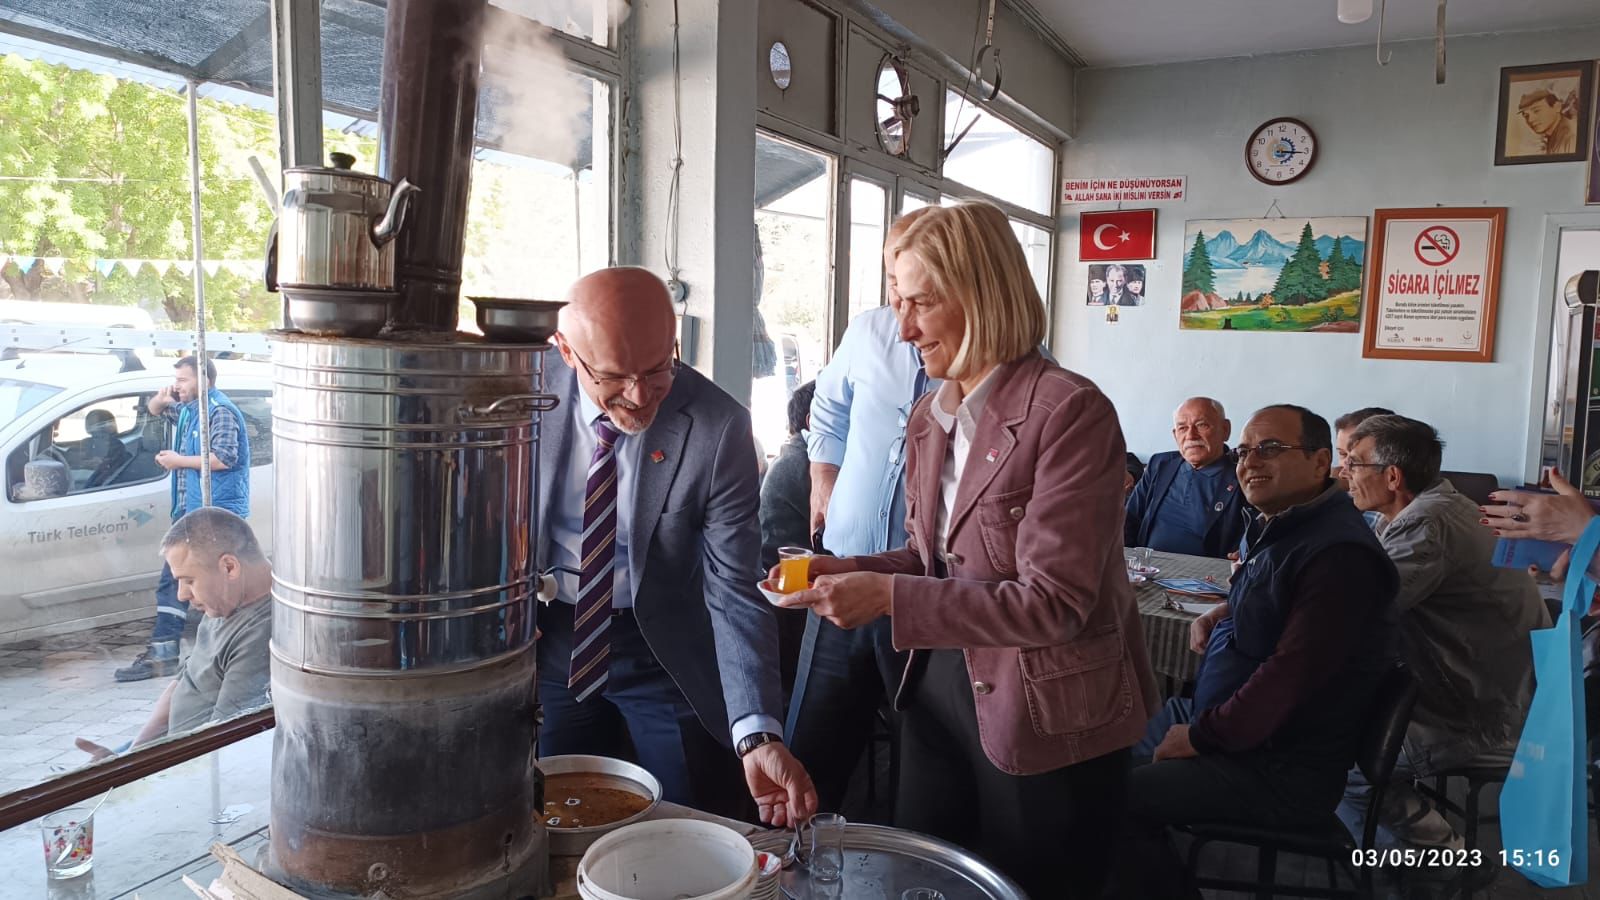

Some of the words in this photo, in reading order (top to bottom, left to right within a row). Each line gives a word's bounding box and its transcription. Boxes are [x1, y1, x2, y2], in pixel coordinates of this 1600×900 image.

[1267, 129, 1273, 137] 11
[1278, 125, 1287, 133] 12
[1065, 180, 1088, 190] BENİM
[1090, 179, 1105, 192] İÇİN
[1107, 180, 1117, 190] NE
[1119, 177, 1182, 191] DÜŞÜNÜYORSAN
[1074, 192, 1095, 202] ALLAH
[1095, 191, 1111, 201] SANA
[1113, 190, 1122, 200] İKİ
[1148, 189, 1171, 200] VERSİN
[1387, 269, 1430, 295] SİGARA
[1433, 269, 1480, 300] İÇİLMEZ
[27, 529, 62, 544] Türk
[67, 521, 129, 539] Telekom
